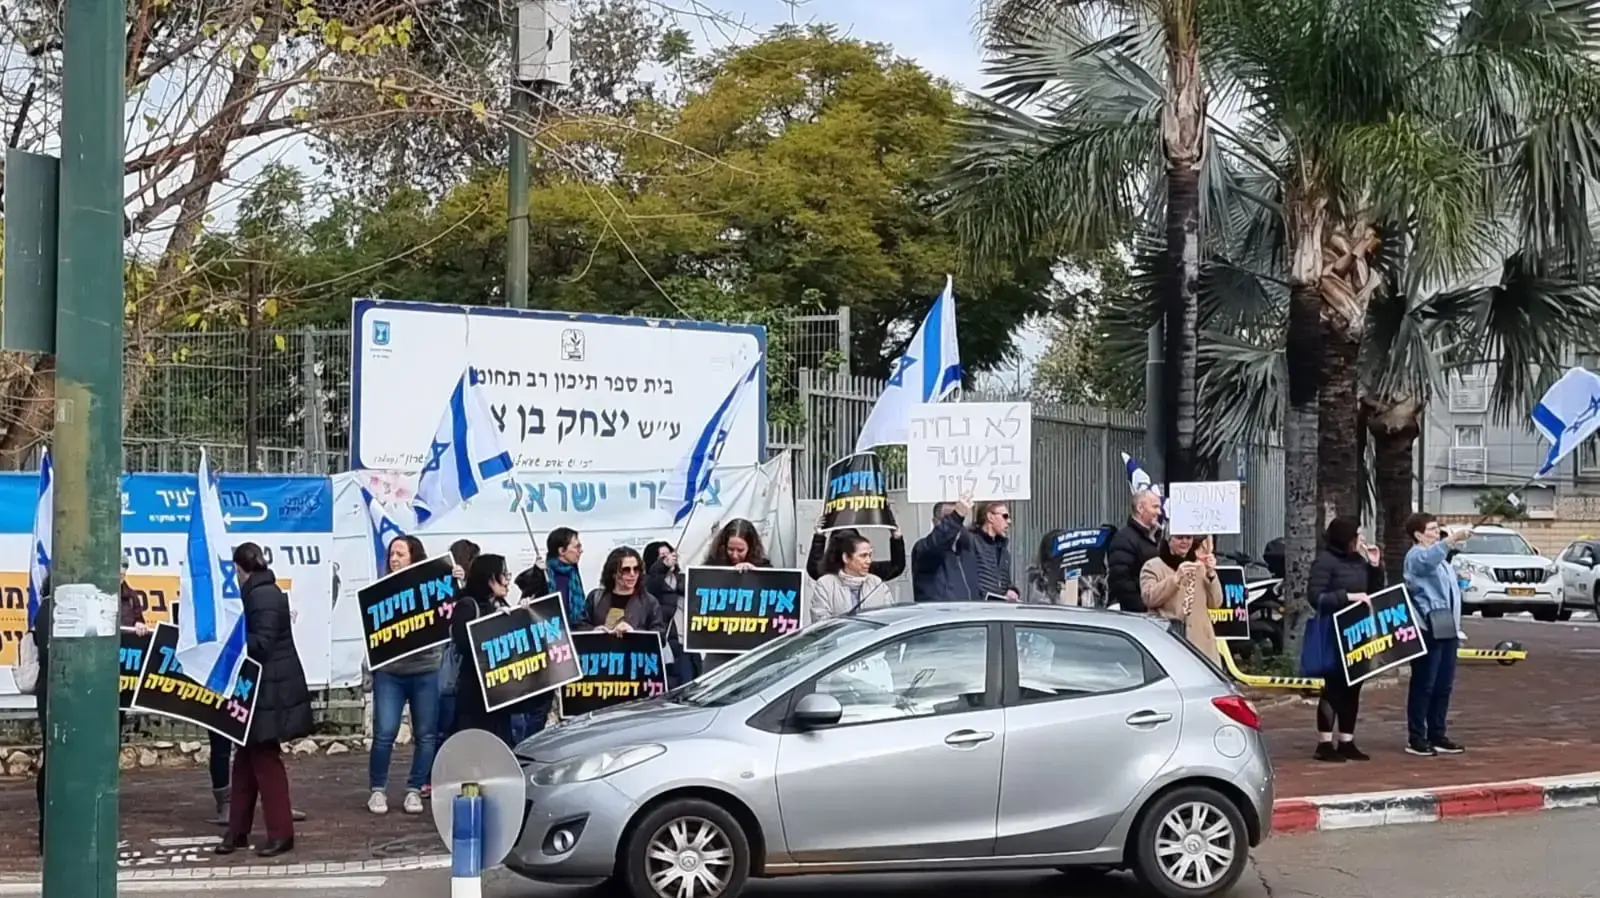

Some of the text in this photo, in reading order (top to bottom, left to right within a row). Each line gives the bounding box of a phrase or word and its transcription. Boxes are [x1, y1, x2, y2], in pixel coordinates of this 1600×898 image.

[476, 368, 674, 395] בית ספר תיכון רב תחומ
[516, 403, 546, 443] בן
[556, 406, 630, 444] יצחק
[911, 404, 1021, 439] לא נחיה
[926, 445, 1022, 467] במשטר
[502, 479, 608, 513] ישראל
[831, 471, 874, 500] חינוך
[987, 469, 1021, 494] של
[824, 495, 886, 515] דמוקרטיה
[280, 545, 320, 565] עוד
[420, 575, 455, 610] אין
[695, 587, 797, 617] אין חינוך
[1225, 583, 1245, 608] אין
[367, 588, 416, 631] חינוך
[1208, 605, 1246, 624] בלי דמוק
[369, 601, 457, 649] לי דמוקרטיה
[690, 615, 798, 635] בלי דמוקרטיה
[1343, 603, 1409, 651] אין חינוך
[481, 616, 563, 669] אין חינוך
[1346, 626, 1417, 667] בלי דמוקרטיה
[485, 644, 573, 689] בלי דמוקרטיה
[578, 652, 660, 680] אין חינו
[144, 673, 225, 709] דמוקרטיה
[565, 679, 664, 700] בלי דמוקרטיה
[227, 700, 249, 723] בלי
